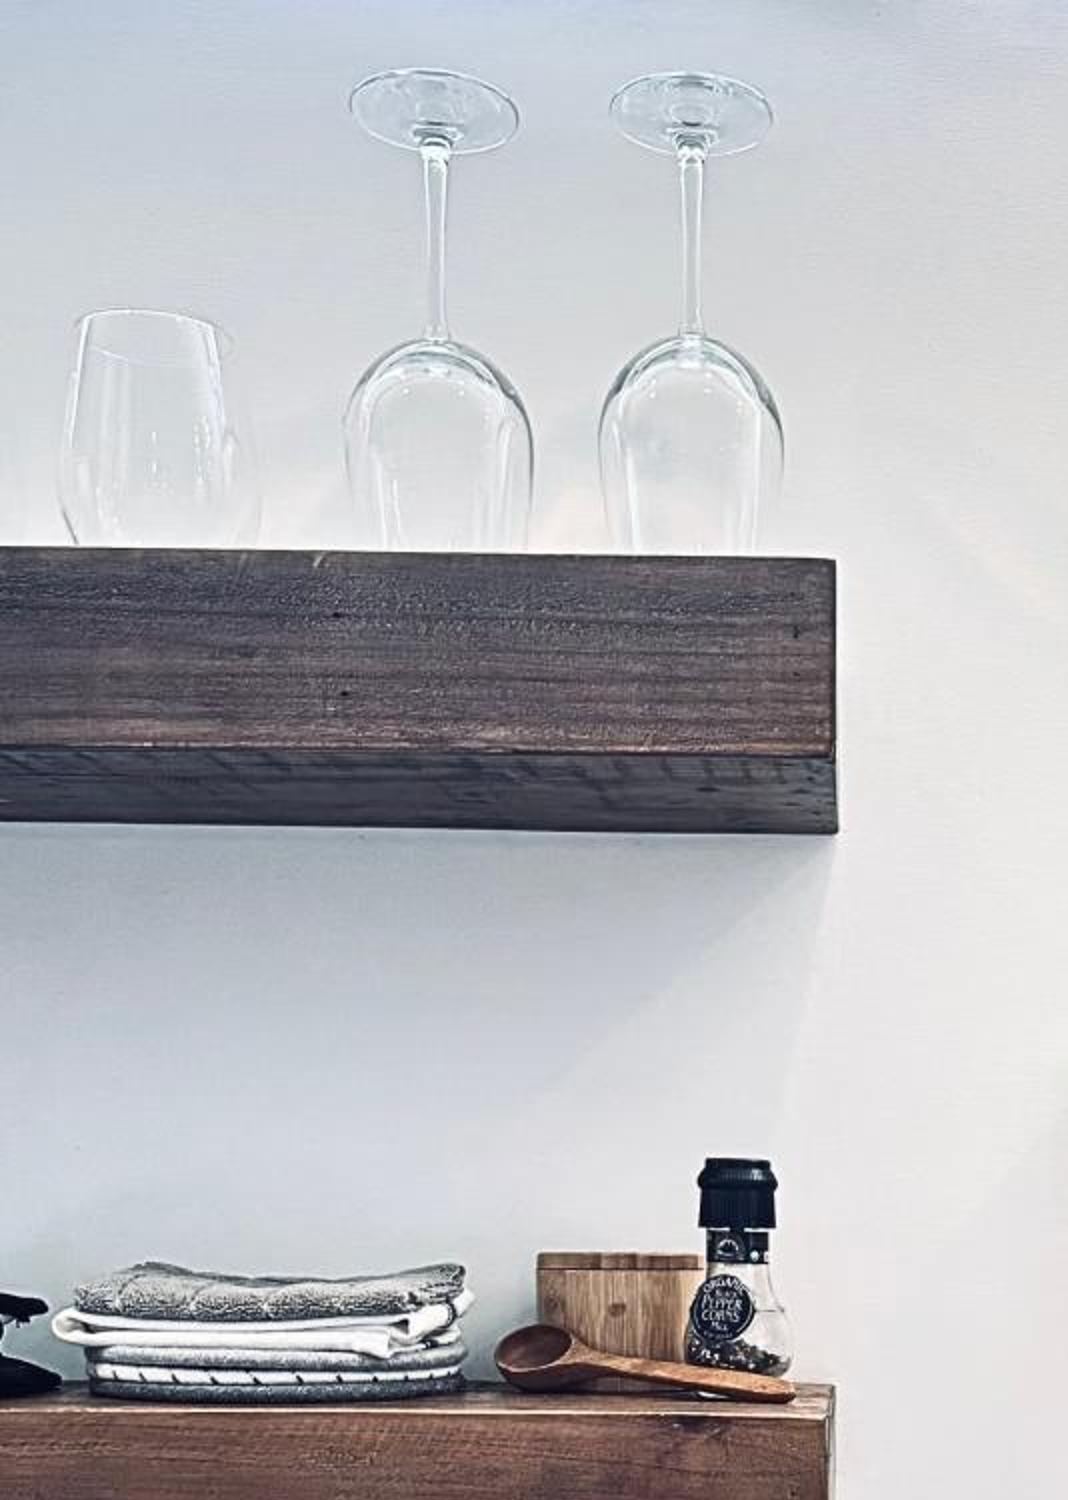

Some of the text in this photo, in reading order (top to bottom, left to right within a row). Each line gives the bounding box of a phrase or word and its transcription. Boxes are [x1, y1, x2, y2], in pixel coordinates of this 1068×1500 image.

[703, 1277, 749, 1294] ORGANIC
[701, 1294, 742, 1311] PEPPER
[701, 1309, 740, 1322] CORNS
